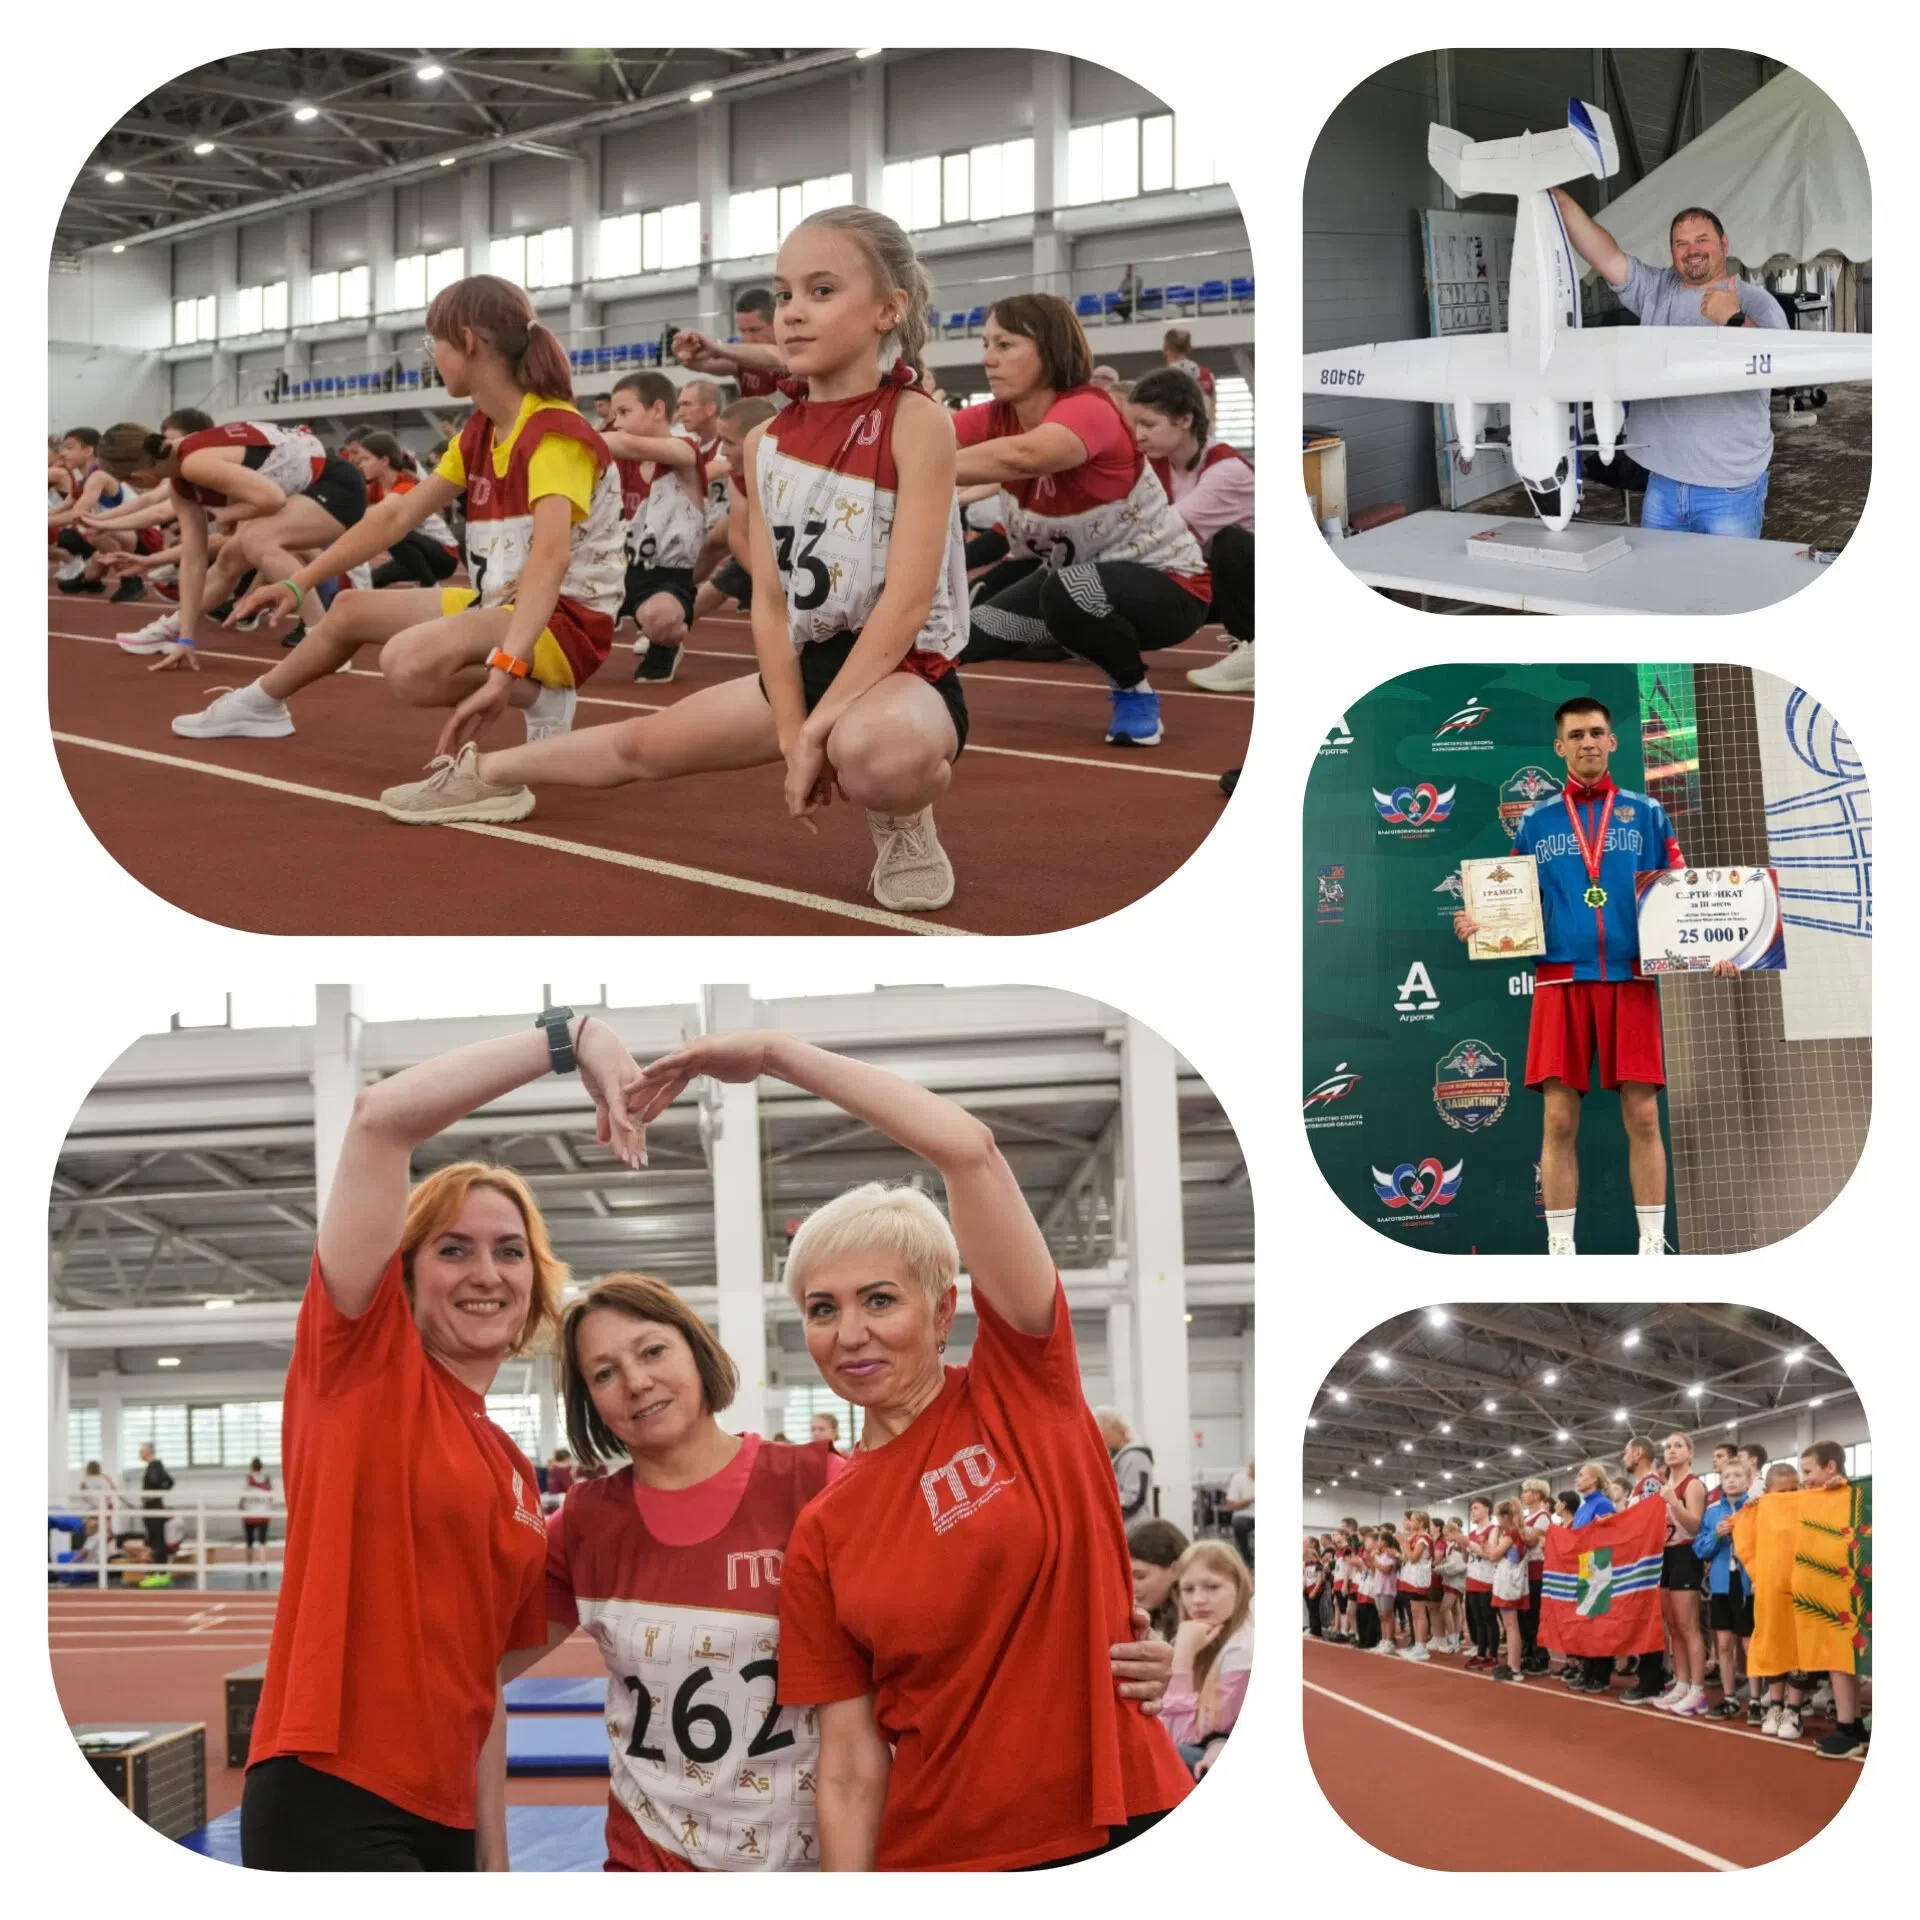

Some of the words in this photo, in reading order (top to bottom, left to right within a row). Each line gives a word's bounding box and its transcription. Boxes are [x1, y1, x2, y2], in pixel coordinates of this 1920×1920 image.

[1745, 354, 1771, 375] RF
[1320, 369, 1365, 385] 49408
[1535, 827, 1644, 864] RUSSIA
[1483, 888, 1524, 897] ГРАМОТА
[1675, 890, 1743, 899] СРТИИКАТ
[1679, 929, 1699, 943] 25
[1704, 927, 1734, 942] 000
[1400, 1013, 1435, 1022] Агротэк
[1445, 1096, 1498, 1110] ЗАЩИТНИК
[920, 1444, 995, 1520] ГТО
[624, 1658, 796, 1764] 262
